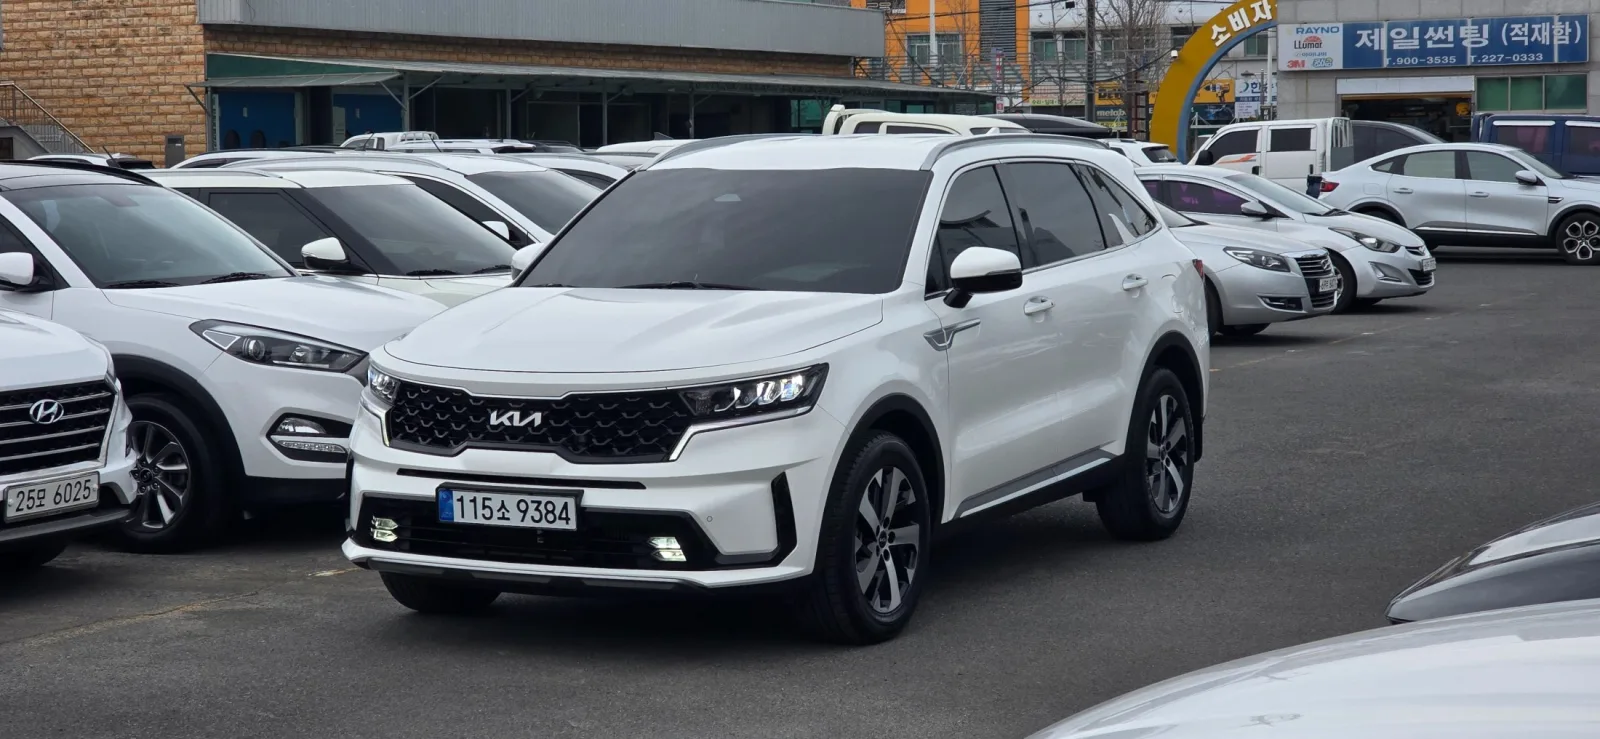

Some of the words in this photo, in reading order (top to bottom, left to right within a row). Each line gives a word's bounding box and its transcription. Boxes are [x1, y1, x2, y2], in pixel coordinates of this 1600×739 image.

[1295, 26, 1340, 35] RAYNO
[1355, 24, 1489, 50] 제일썬팅
[1501, 20, 1582, 46] (적재함)
[1287, 60, 1306, 68] 3M
[1470, 53, 1544, 63] T.227-0333
[490, 410, 542, 427] KIA
[15, 488, 46, 512] 25모
[53, 479, 91, 505] 6025
[456, 495, 511, 521] 115소
[516, 499, 571, 525] 9384
